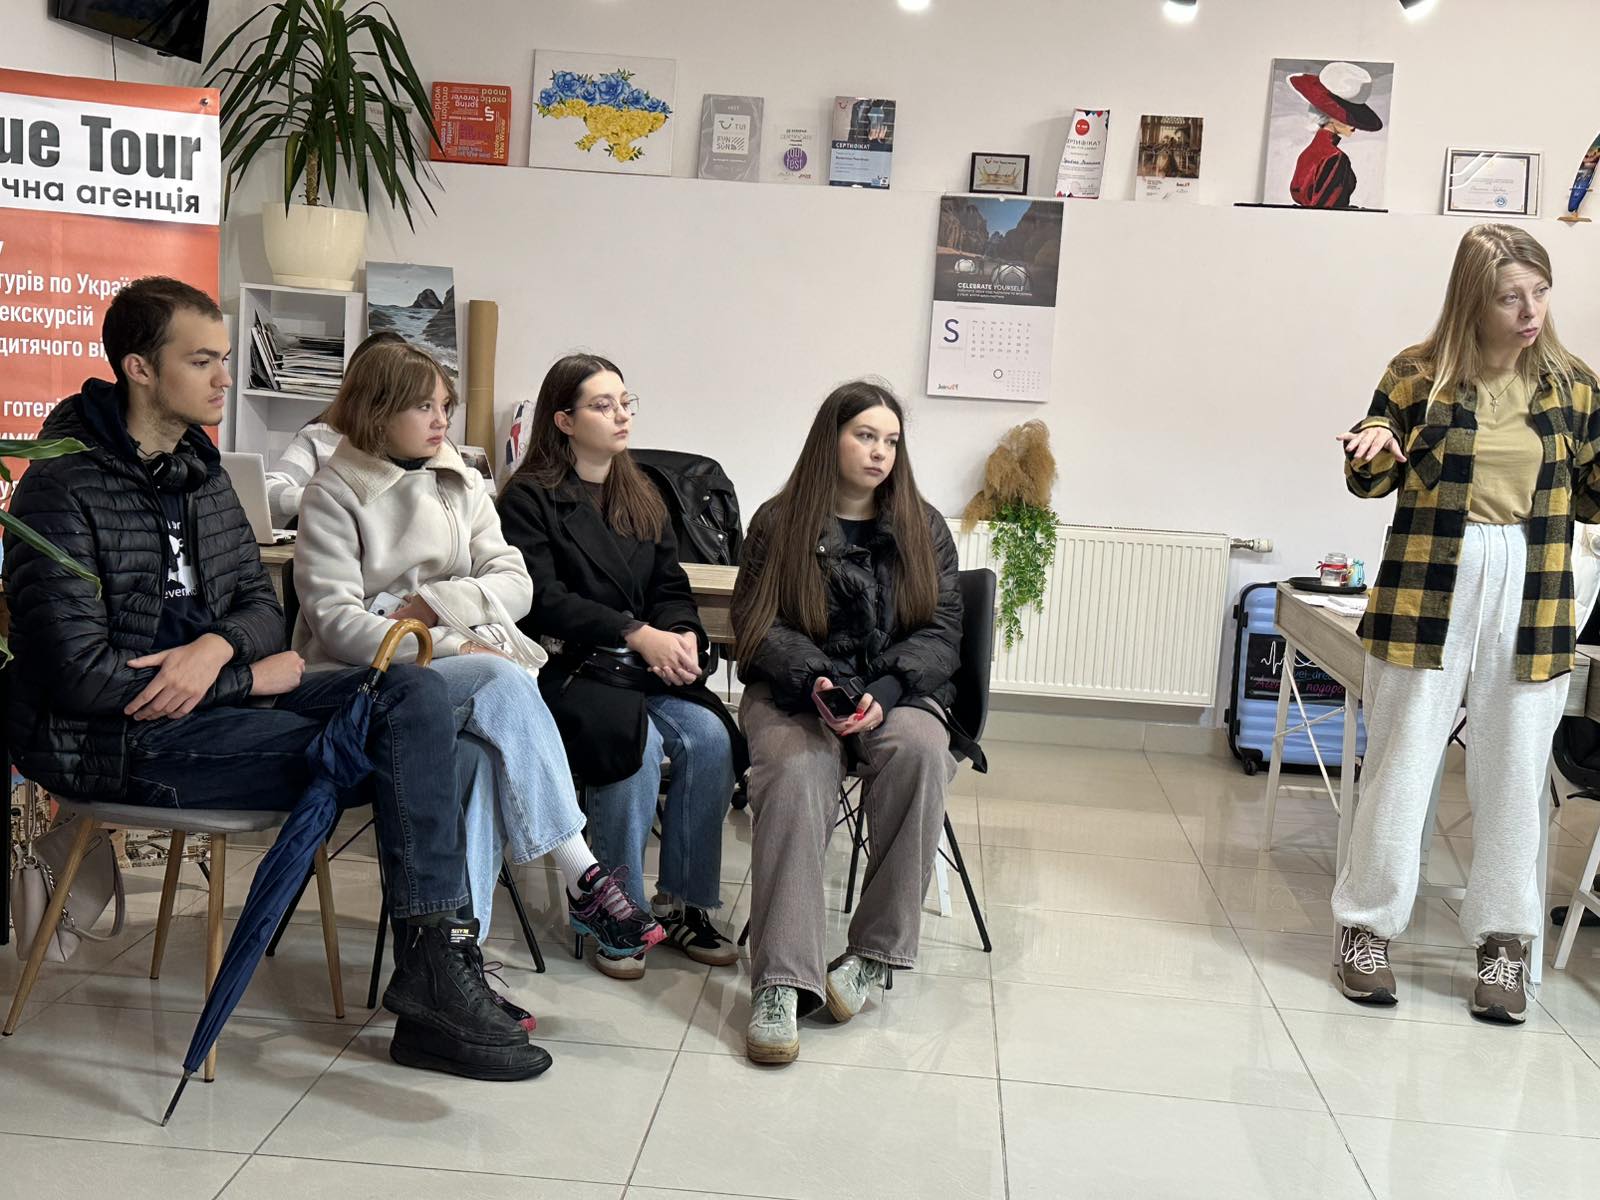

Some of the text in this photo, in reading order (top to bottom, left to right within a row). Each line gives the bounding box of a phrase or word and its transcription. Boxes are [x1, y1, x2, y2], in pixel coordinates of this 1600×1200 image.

[481, 88, 507, 97] mood
[81, 114, 202, 181] Tour
[76, 184, 200, 214] агенція
[50, 277, 72, 293] по
[957, 282, 992, 290] CELEBRATE
[0, 304, 94, 329] екскурсій
[943, 318, 960, 343] S
[89, 336, 110, 362] ві
